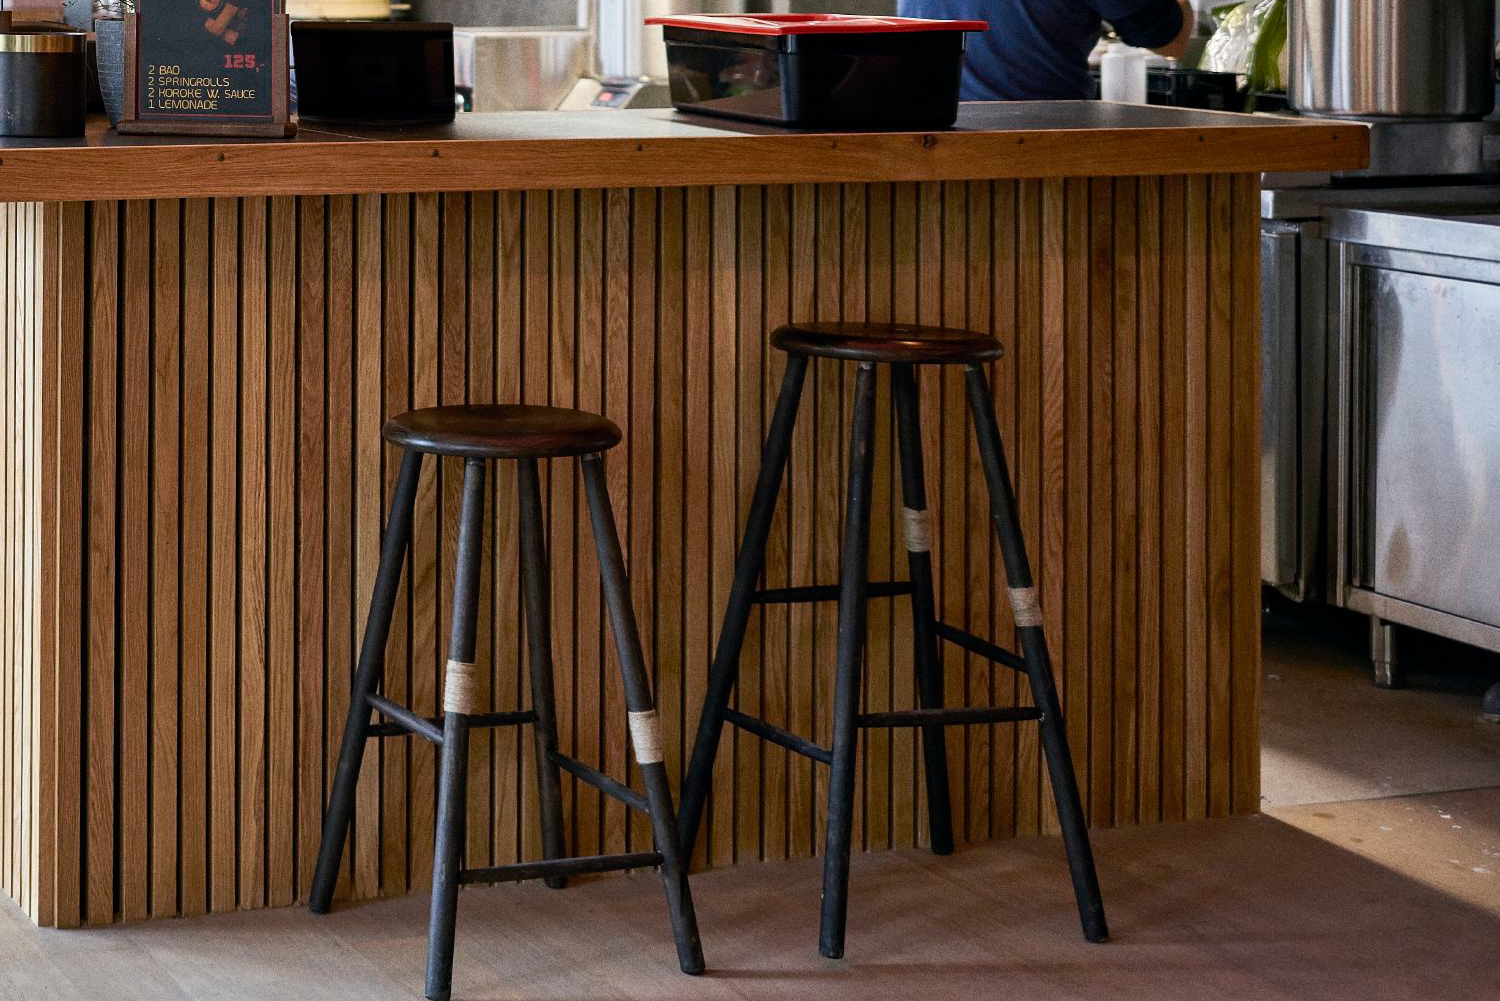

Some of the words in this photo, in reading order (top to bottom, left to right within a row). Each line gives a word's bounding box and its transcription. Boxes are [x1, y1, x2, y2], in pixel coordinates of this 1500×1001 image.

[148, 65, 155, 75] 2
[159, 65, 180, 75] BAO
[148, 77, 155, 86] 2
[158, 77, 230, 87] SPRINGROLLS
[148, 88, 155, 97] 2
[158, 88, 202, 98] KOROKE
[206, 89, 220, 99] W.
[224, 89, 256, 99] SAUCE
[148, 100, 155, 109] 1
[158, 100, 218, 110] LEMONADE
